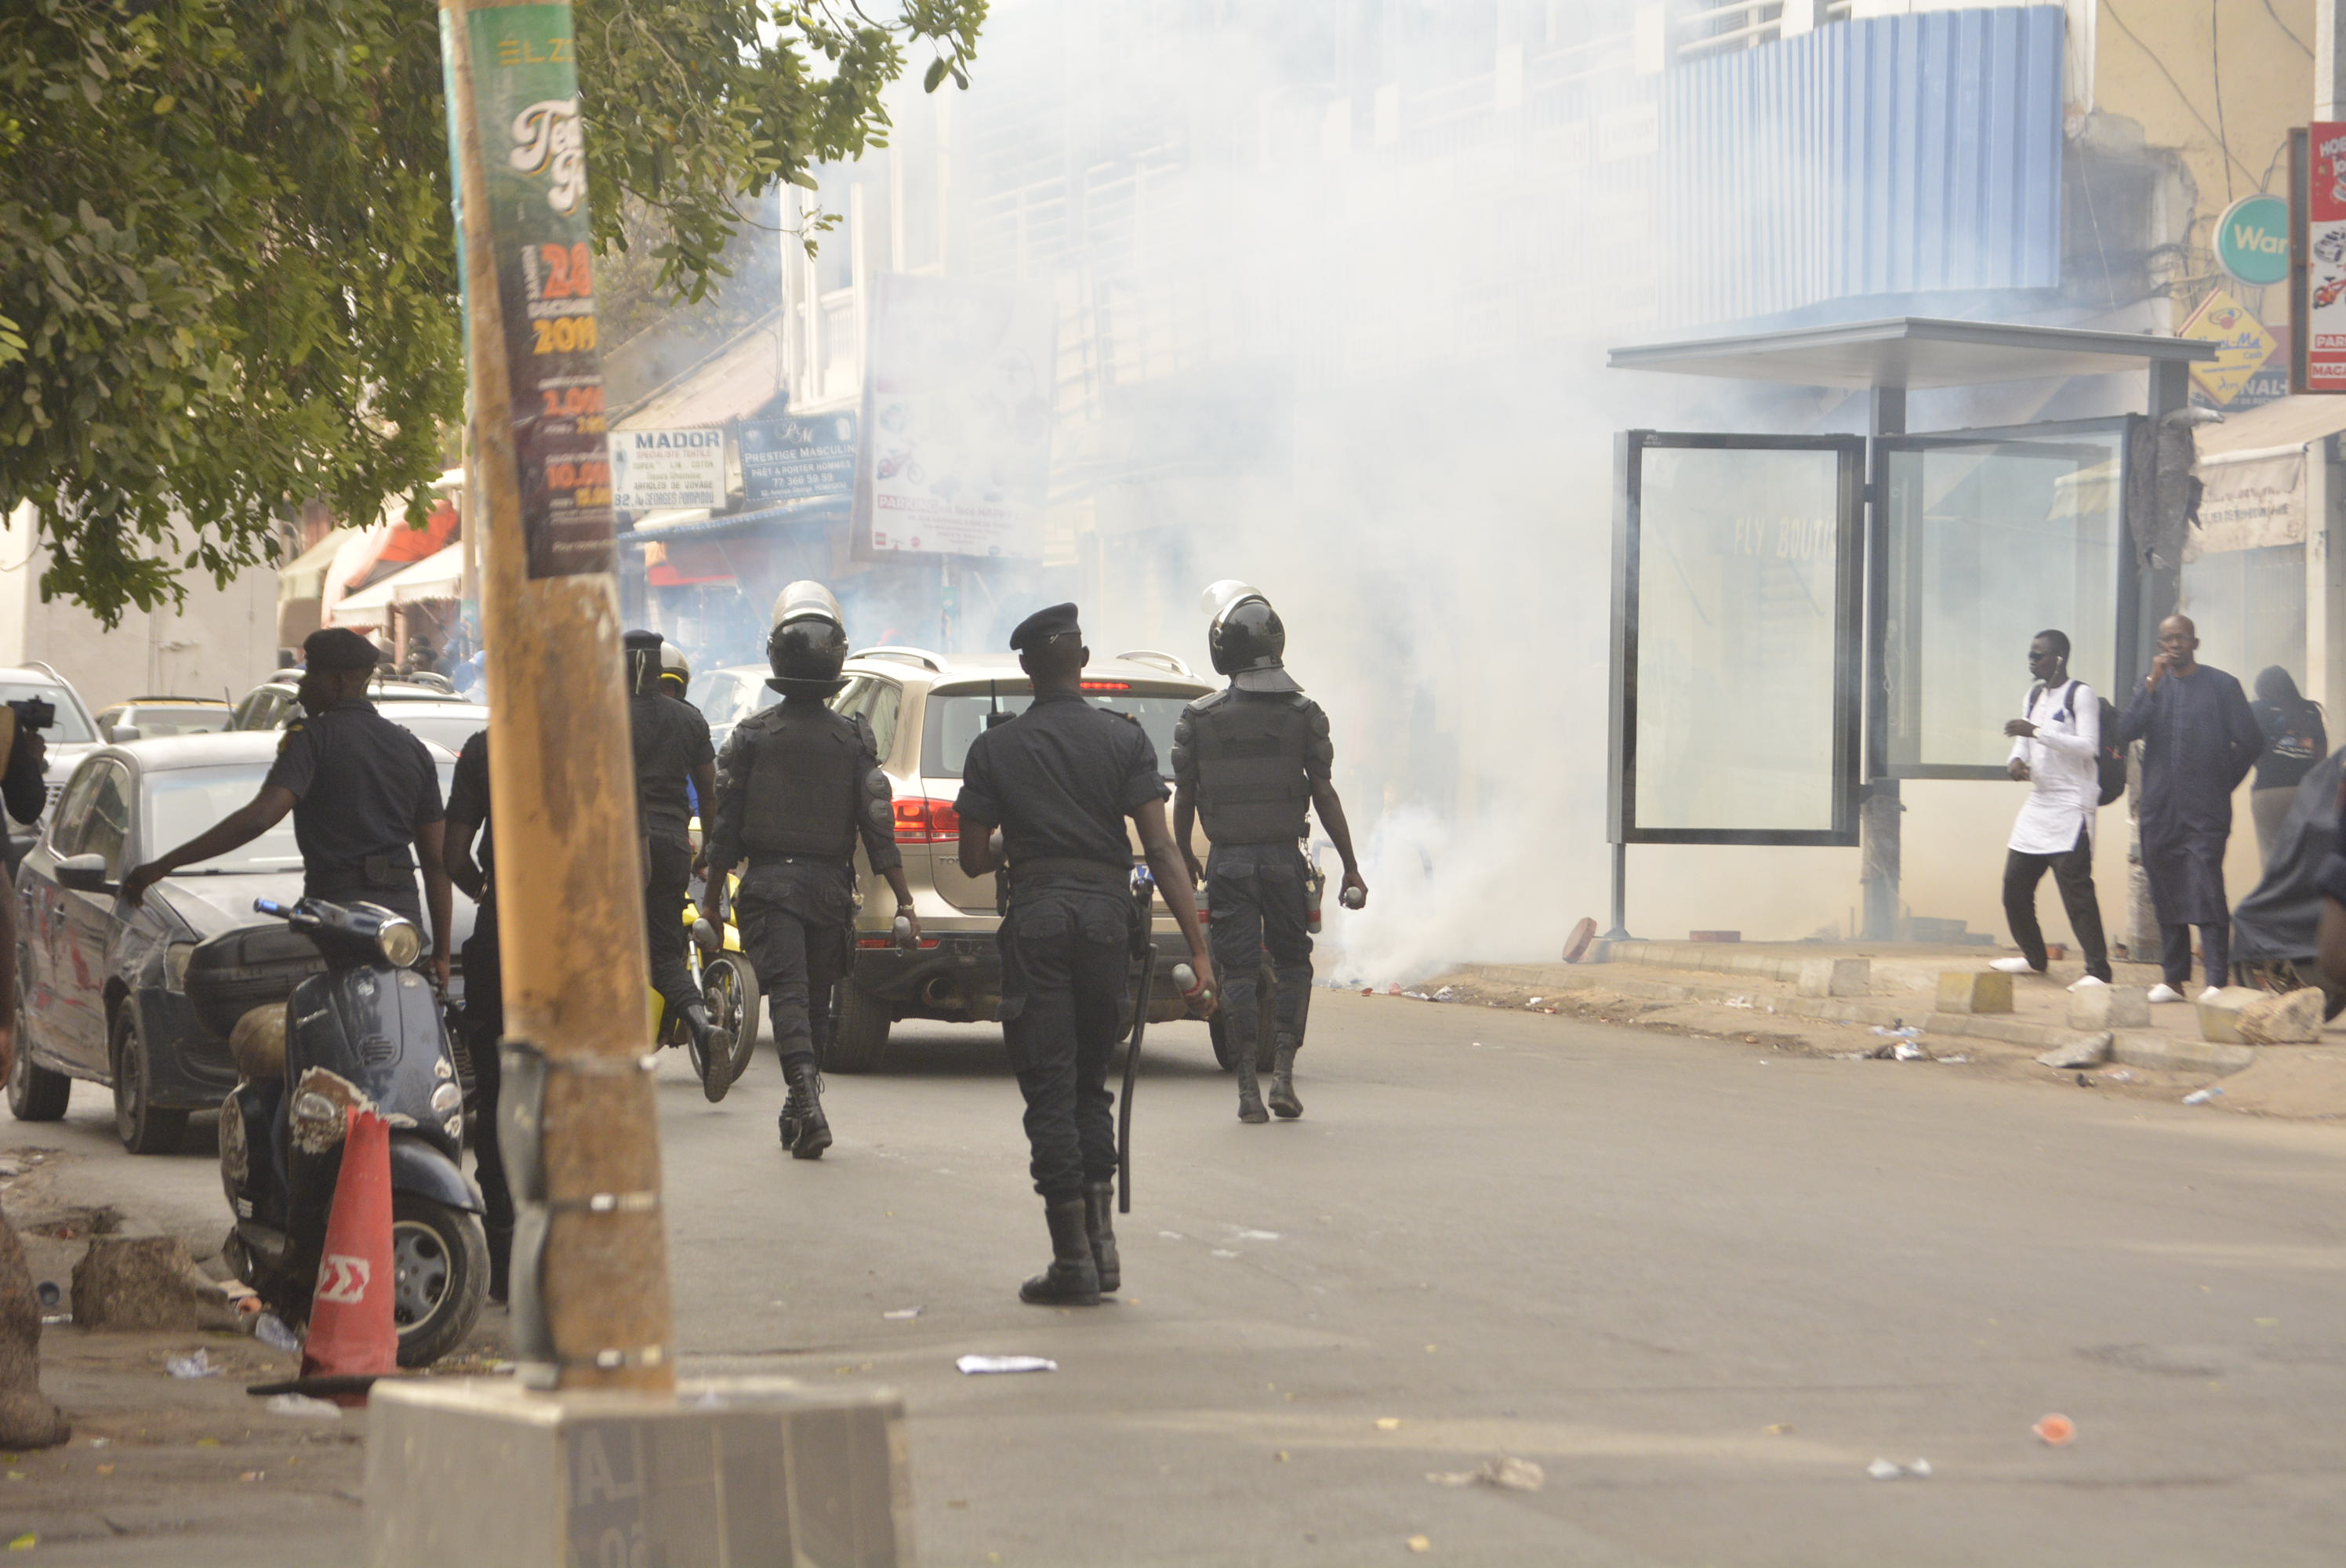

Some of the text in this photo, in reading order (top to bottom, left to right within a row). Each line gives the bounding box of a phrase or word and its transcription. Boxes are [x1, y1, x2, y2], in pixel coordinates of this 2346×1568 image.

[2317, 335, 2346, 347] PAR
[635, 431, 720, 448] MADOR
[745, 444, 855, 463] PRESTIGE MASCULIN
[783, 463, 815, 474] PORTER
[816, 459, 852, 470] HOMMES
[634, 481, 666, 490] ARTICLES
[685, 481, 714, 489] VOYAGE
[772, 477, 784, 488] 77
[879, 495, 938, 511] PARKING
[1734, 515, 1765, 557] FLY
